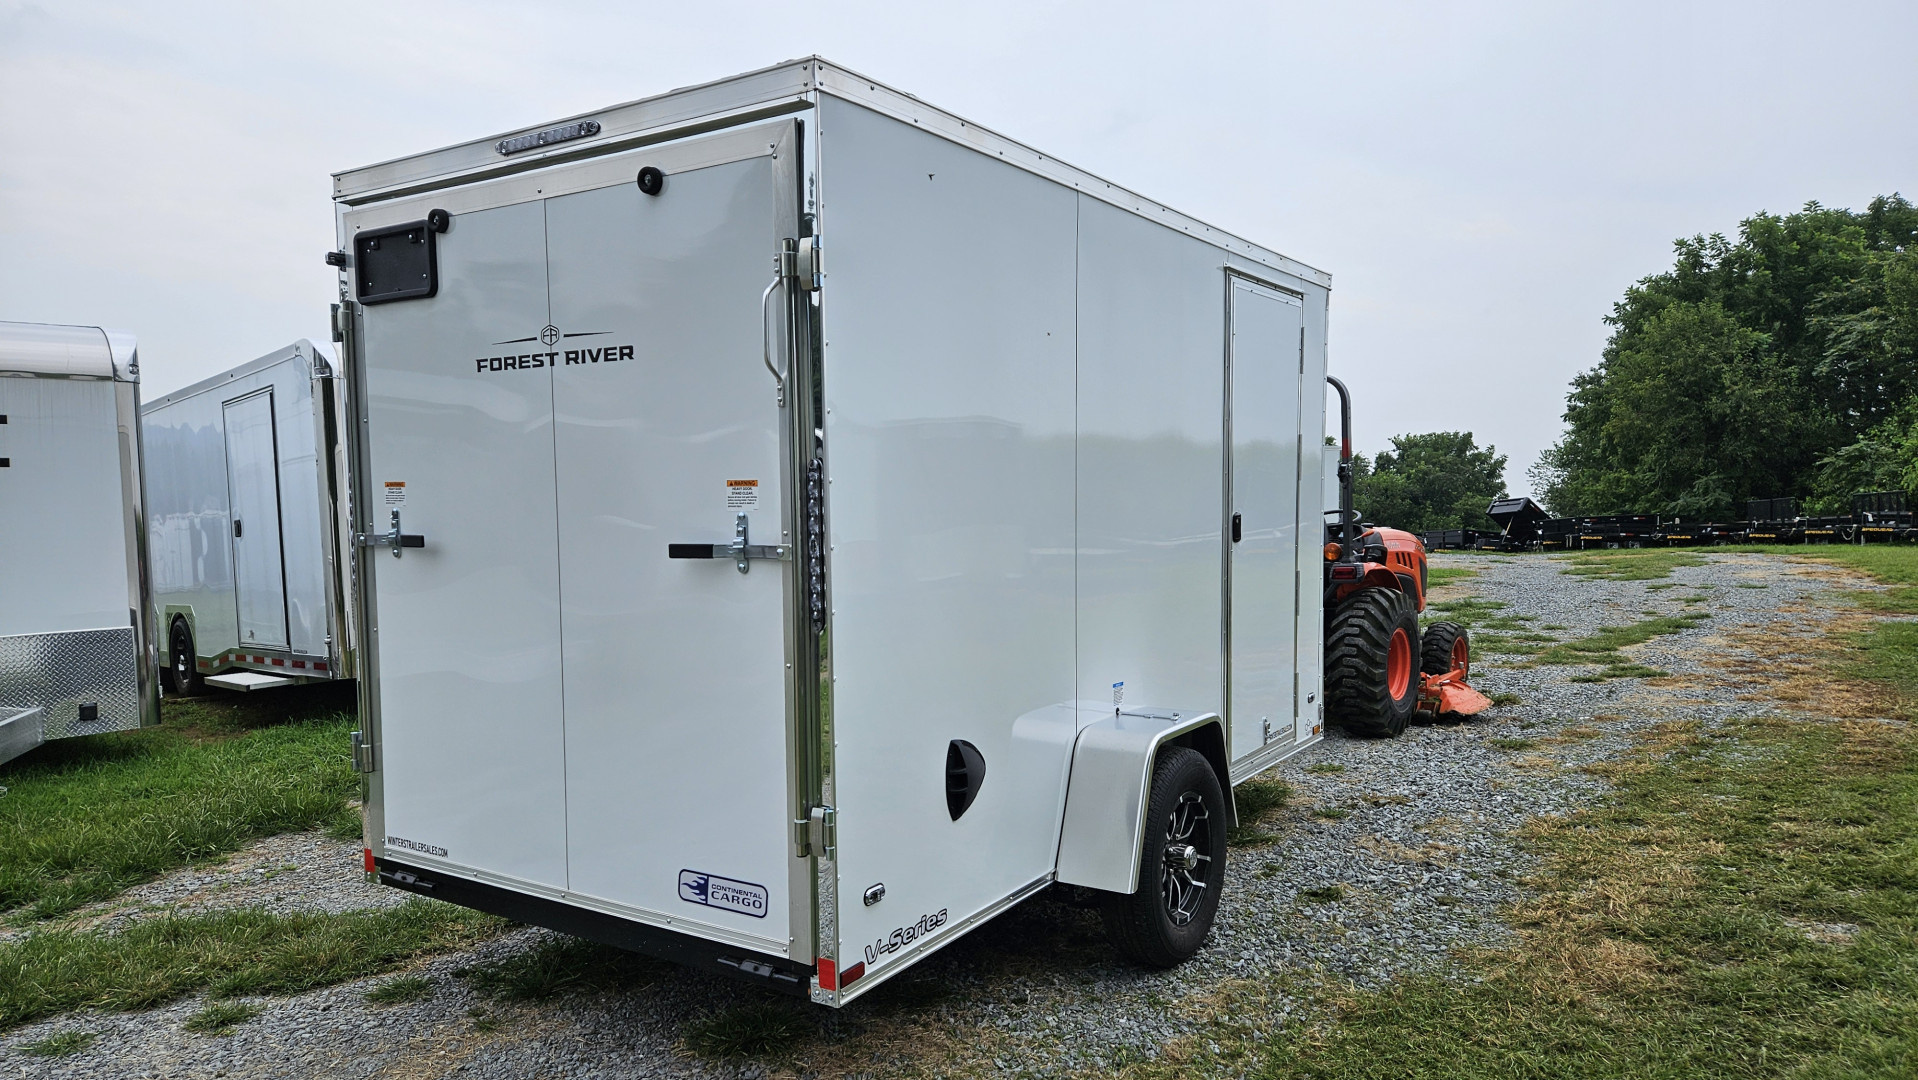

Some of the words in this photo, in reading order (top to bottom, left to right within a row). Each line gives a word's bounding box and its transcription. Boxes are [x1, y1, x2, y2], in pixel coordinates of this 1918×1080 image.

[475, 352, 559, 373] FOREST
[564, 345, 635, 366] RIVER
[711, 884, 762, 899] CONTINENTAL
[711, 891, 762, 909] CARGO
[864, 908, 948, 965] V-Series
